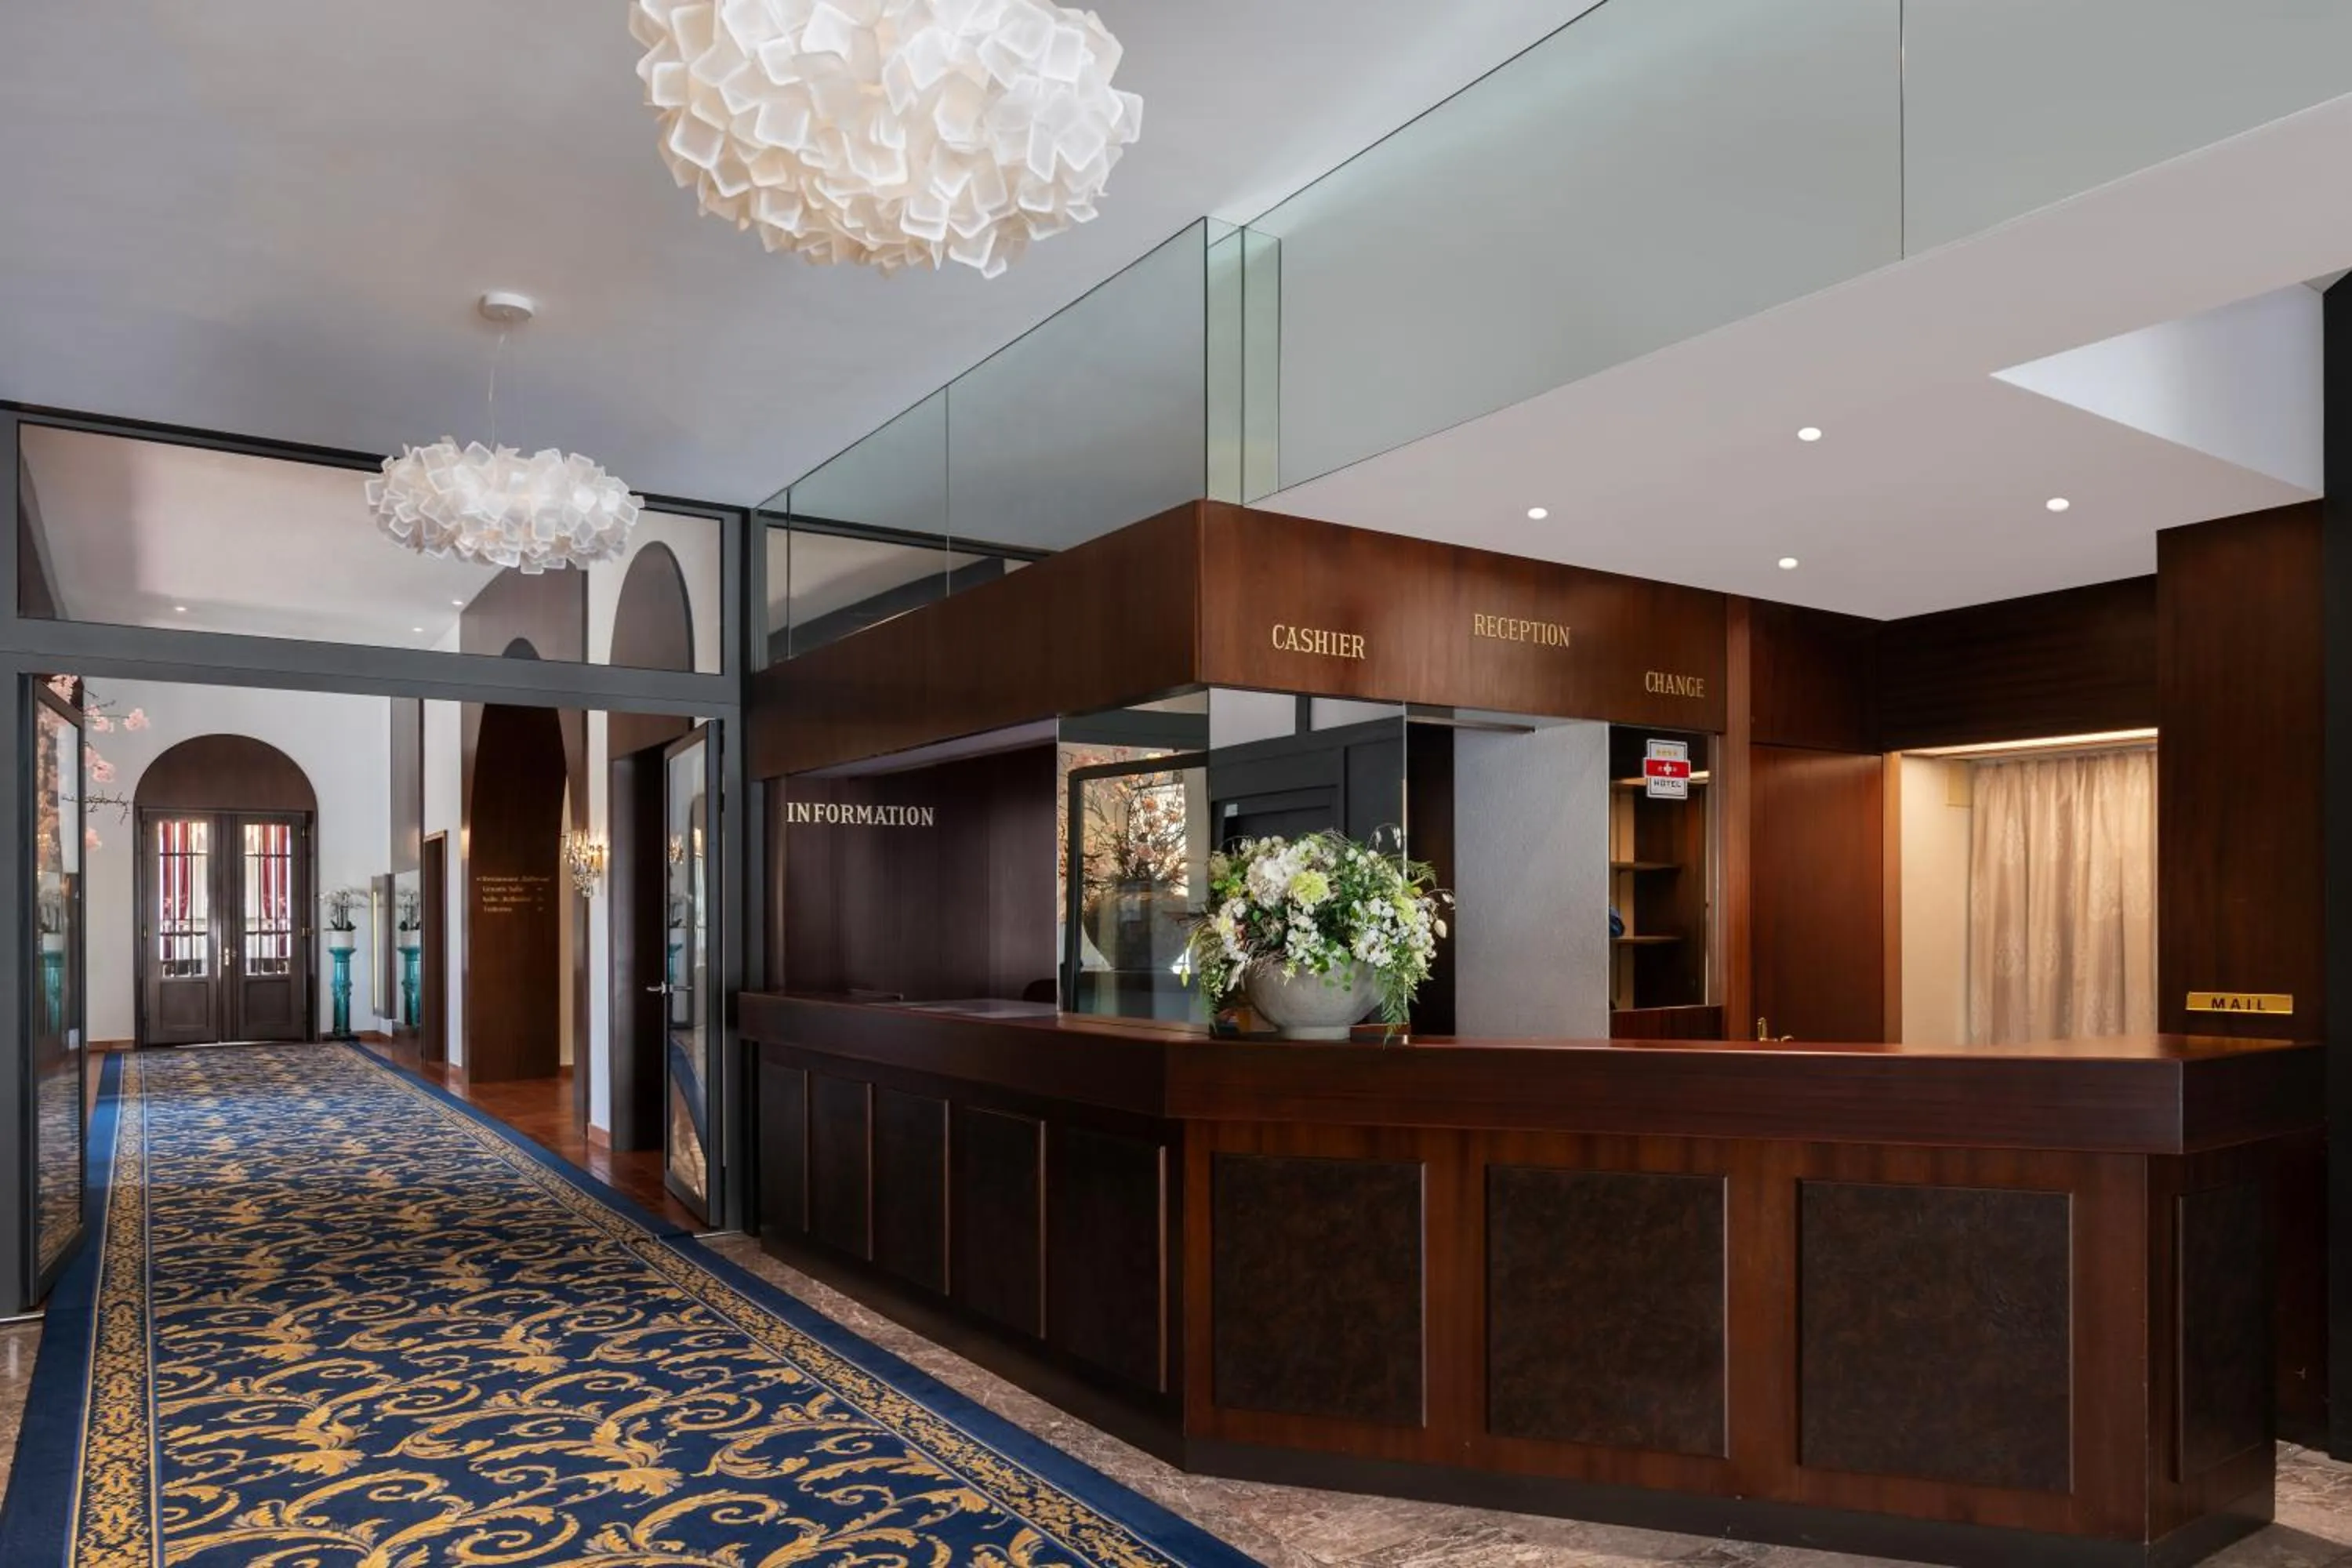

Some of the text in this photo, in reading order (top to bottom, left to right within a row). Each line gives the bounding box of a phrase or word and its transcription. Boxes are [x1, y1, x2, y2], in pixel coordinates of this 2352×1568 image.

[1272, 625, 1365, 659] CASHIER
[1474, 613, 1570, 648] RECEPTION
[1646, 671, 1705, 699] CHANGE
[1653, 779, 1682, 788] HOTEL
[786, 802, 935, 826] INFORMATION
[2212, 997, 2266, 1011] MAIL
